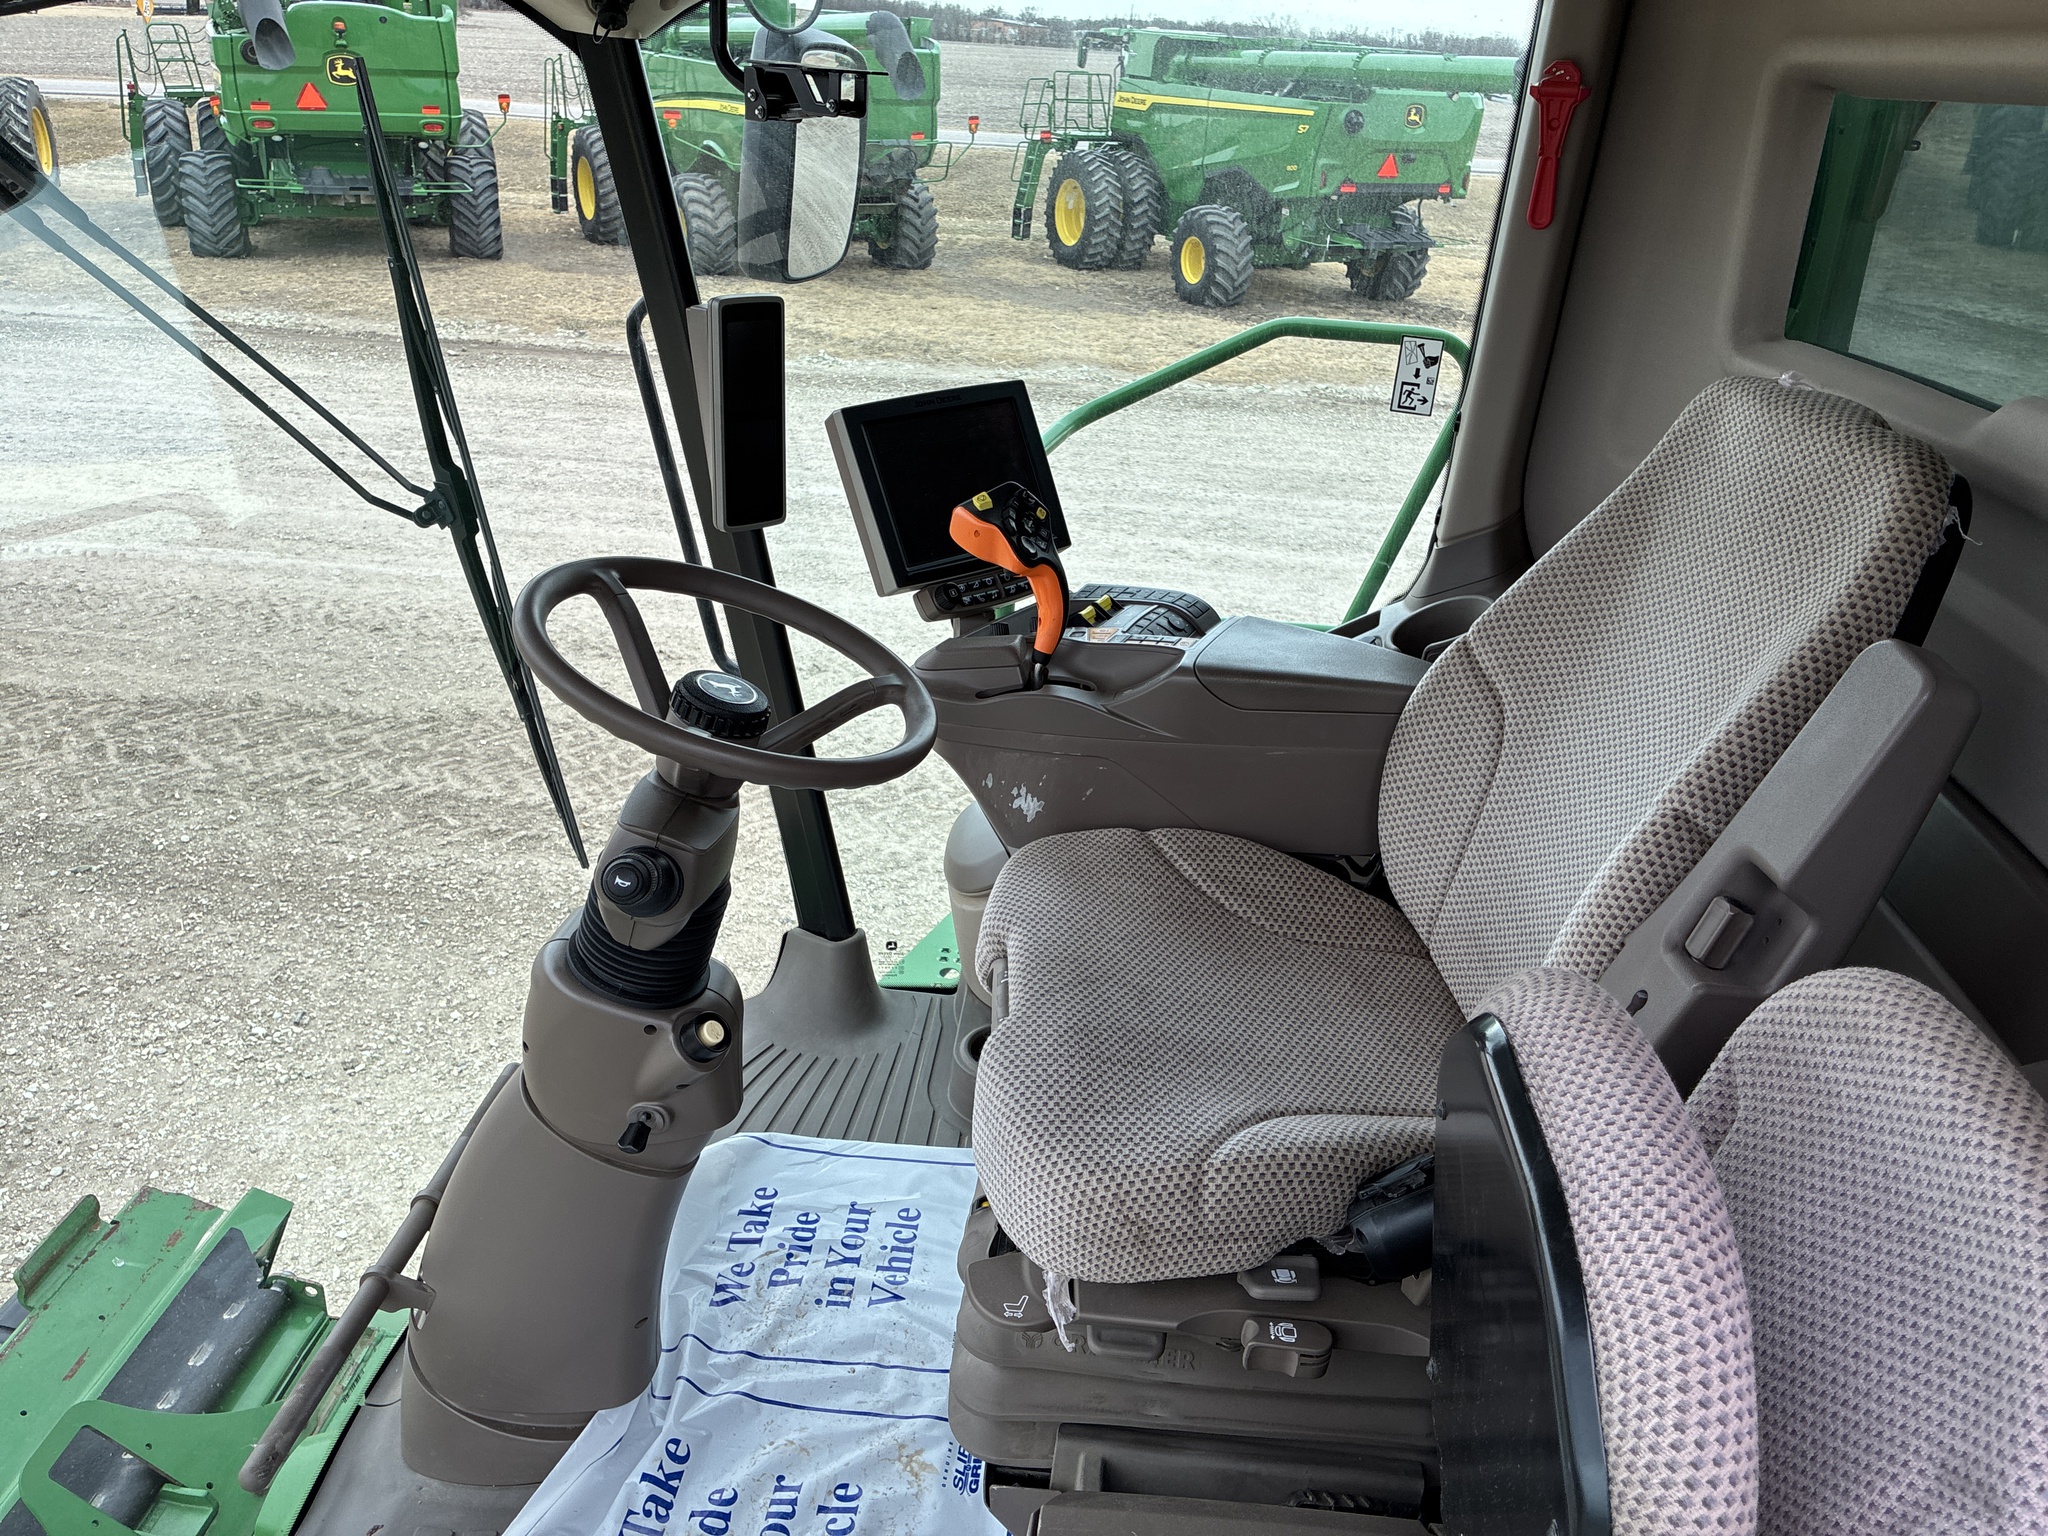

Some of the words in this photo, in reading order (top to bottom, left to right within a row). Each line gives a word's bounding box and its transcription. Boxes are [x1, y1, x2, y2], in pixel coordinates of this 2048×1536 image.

[914, 400, 935, 408] JOHN
[936, 394, 962, 404] DEERE
[726, 1187, 779, 1252] Take
[824, 1201, 872, 1269] Your
[767, 1211, 821, 1290] Pride
[867, 1207, 922, 1308] Vehicle
[709, 1261, 756, 1308] We
[814, 1276, 856, 1309] in
[969, 1458, 982, 1494] GRI
